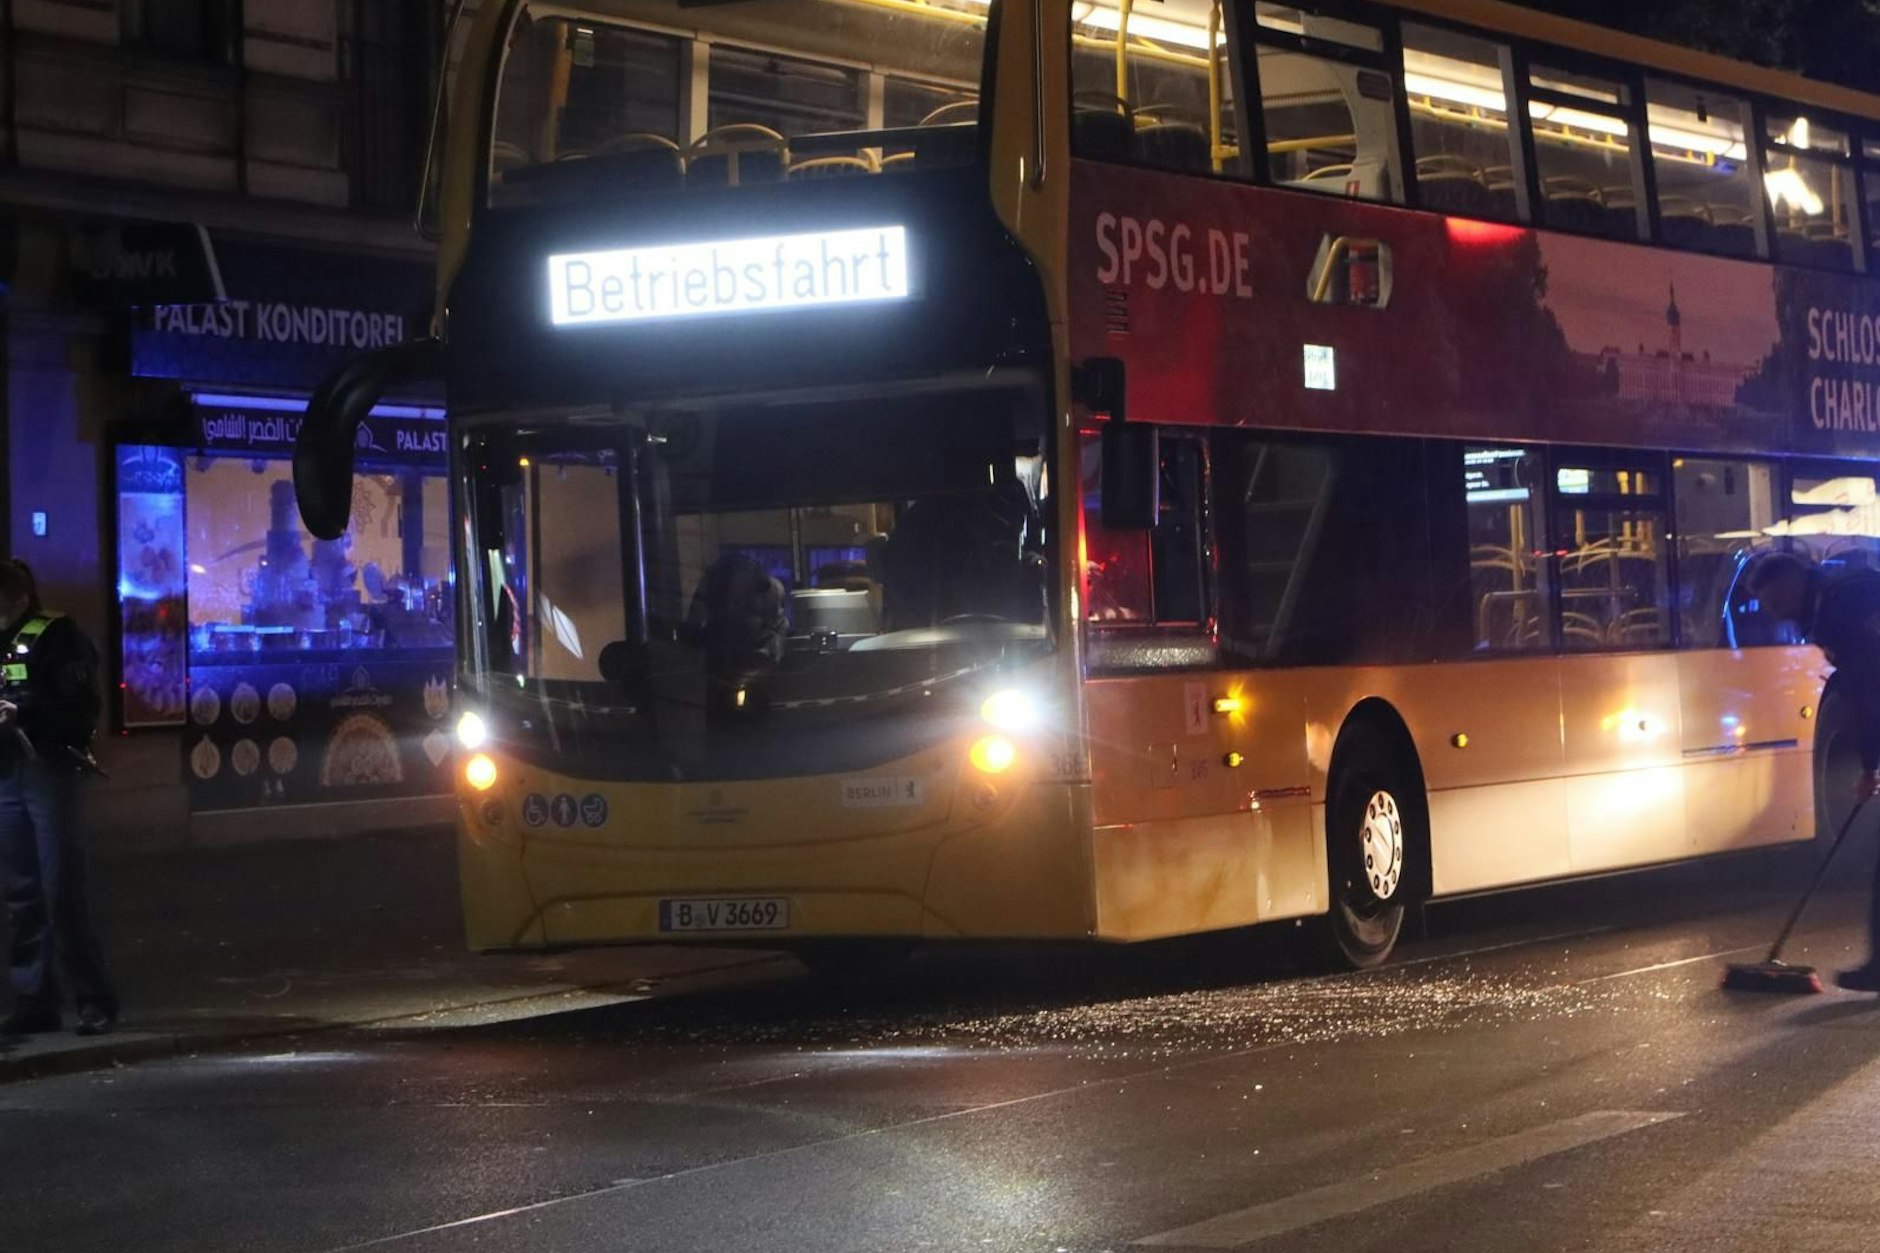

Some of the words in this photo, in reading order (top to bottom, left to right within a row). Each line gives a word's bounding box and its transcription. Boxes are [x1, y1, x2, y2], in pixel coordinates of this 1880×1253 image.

[564, 234, 892, 318] Betriebsfahrt
[1095, 211, 1253, 299] SPSG.DE
[154, 301, 250, 338] PALAST
[257, 303, 404, 349] KONDITOREI
[1810, 376, 1880, 433] CHARL
[396, 430, 447, 451] PALAST
[847, 786, 891, 800] BERLIN
[679, 903, 692, 927] B
[707, 903, 720, 925] V
[725, 902, 778, 926] 3669
